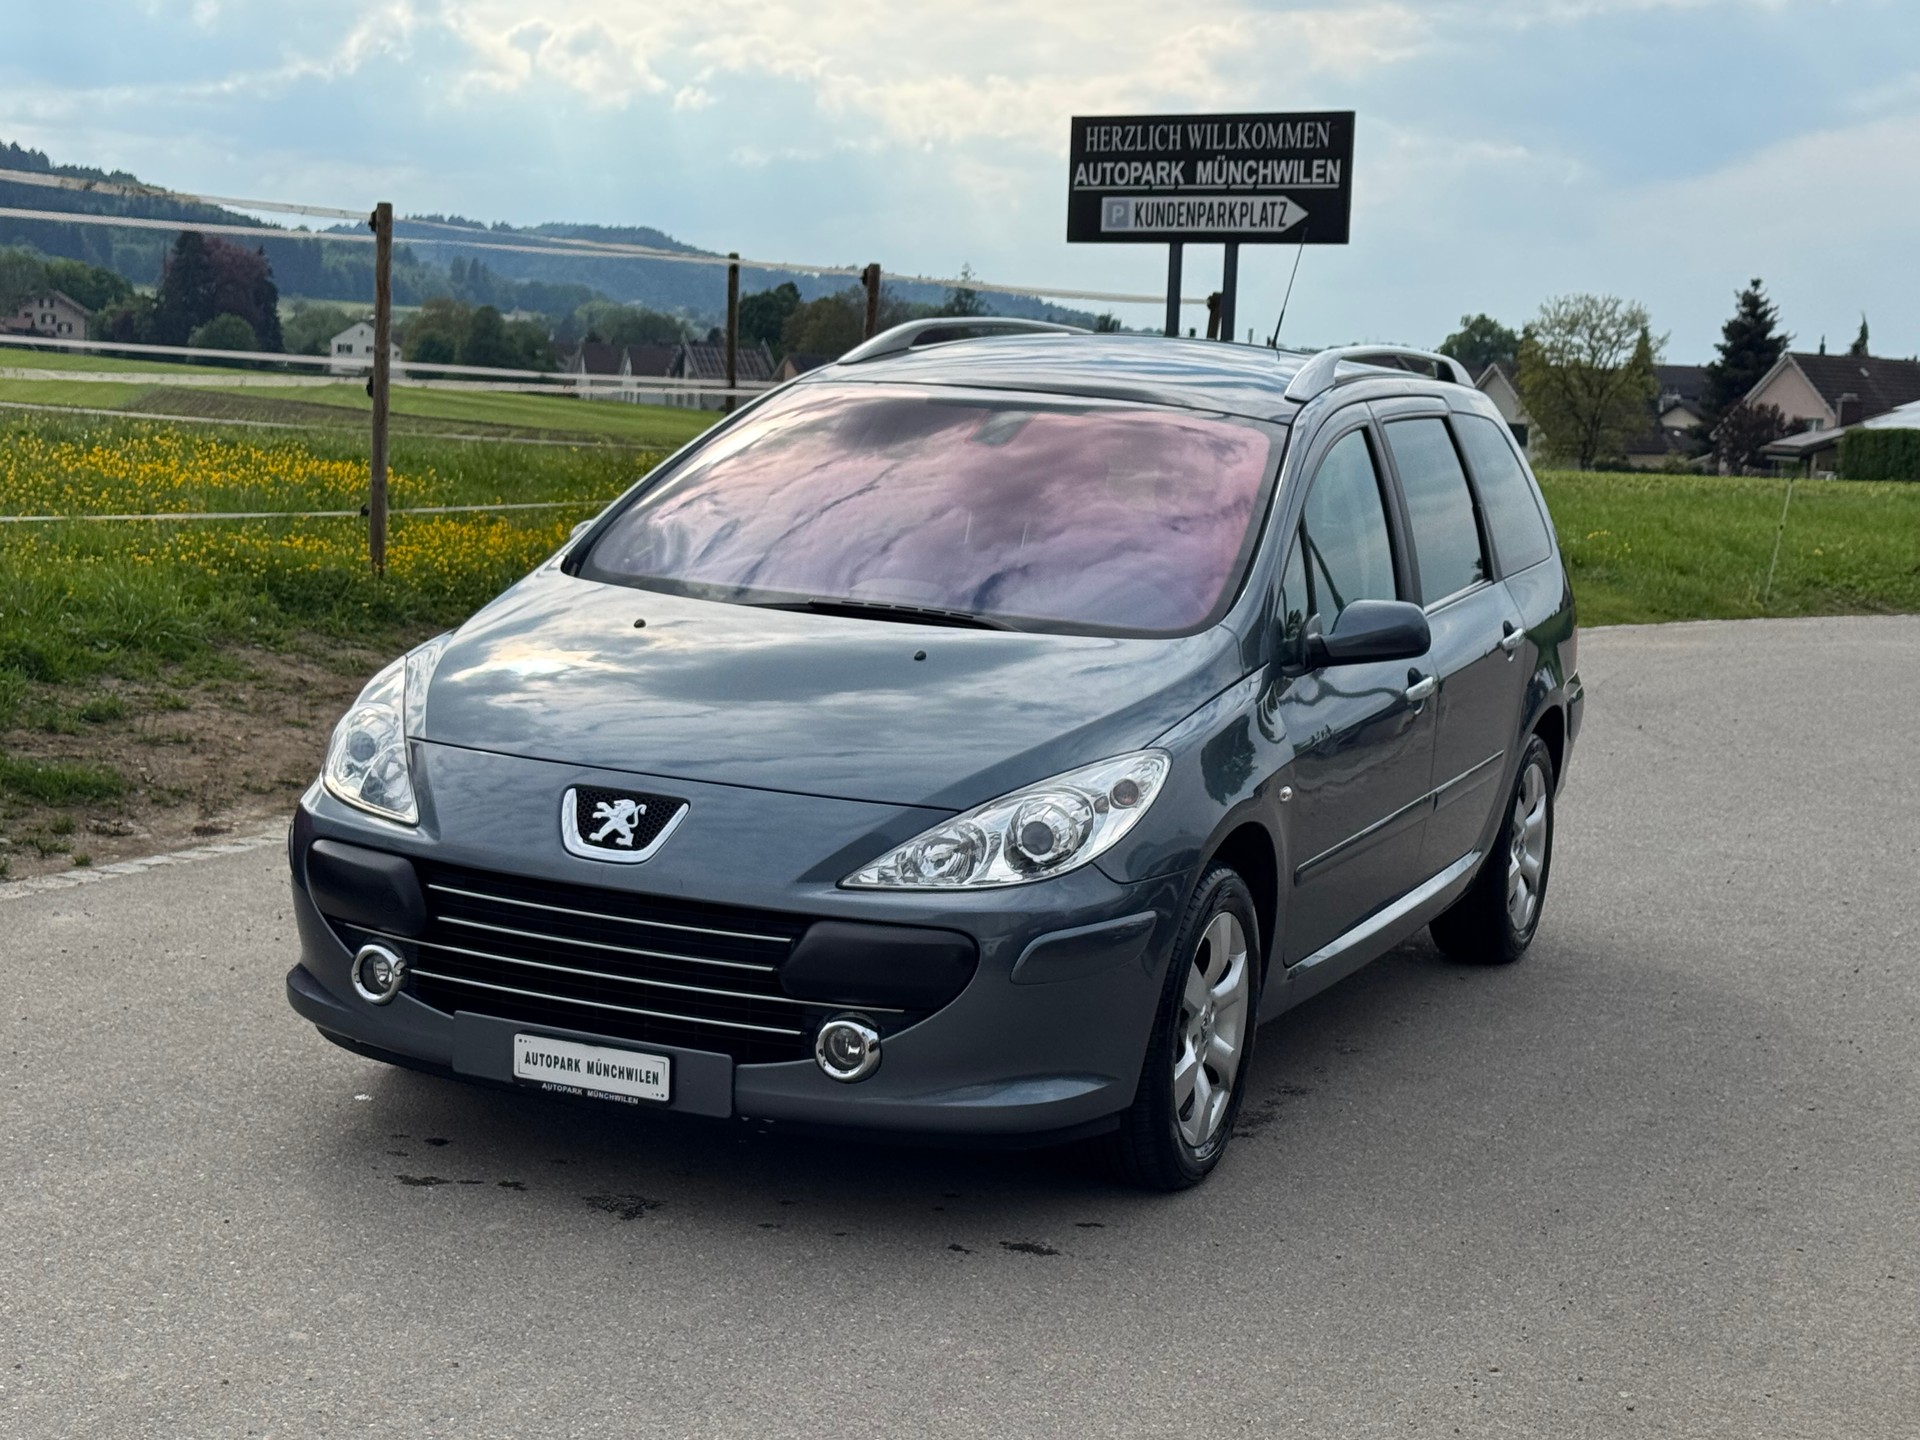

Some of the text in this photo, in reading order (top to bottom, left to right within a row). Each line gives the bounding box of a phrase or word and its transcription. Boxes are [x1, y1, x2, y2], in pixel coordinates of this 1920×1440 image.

[1085, 122, 1331, 152] HERZLICH WILLKOMMEN
[1074, 155, 1341, 185] AUTOPARK MÜNCHWILEN
[1112, 201, 1288, 228] P KUNDENPARKPLATZ
[524, 1051, 660, 1086] AUTOPARK MÜNCHWILEN
[541, 1082, 639, 1105] AUTOPARK MÜNCHWILEN
